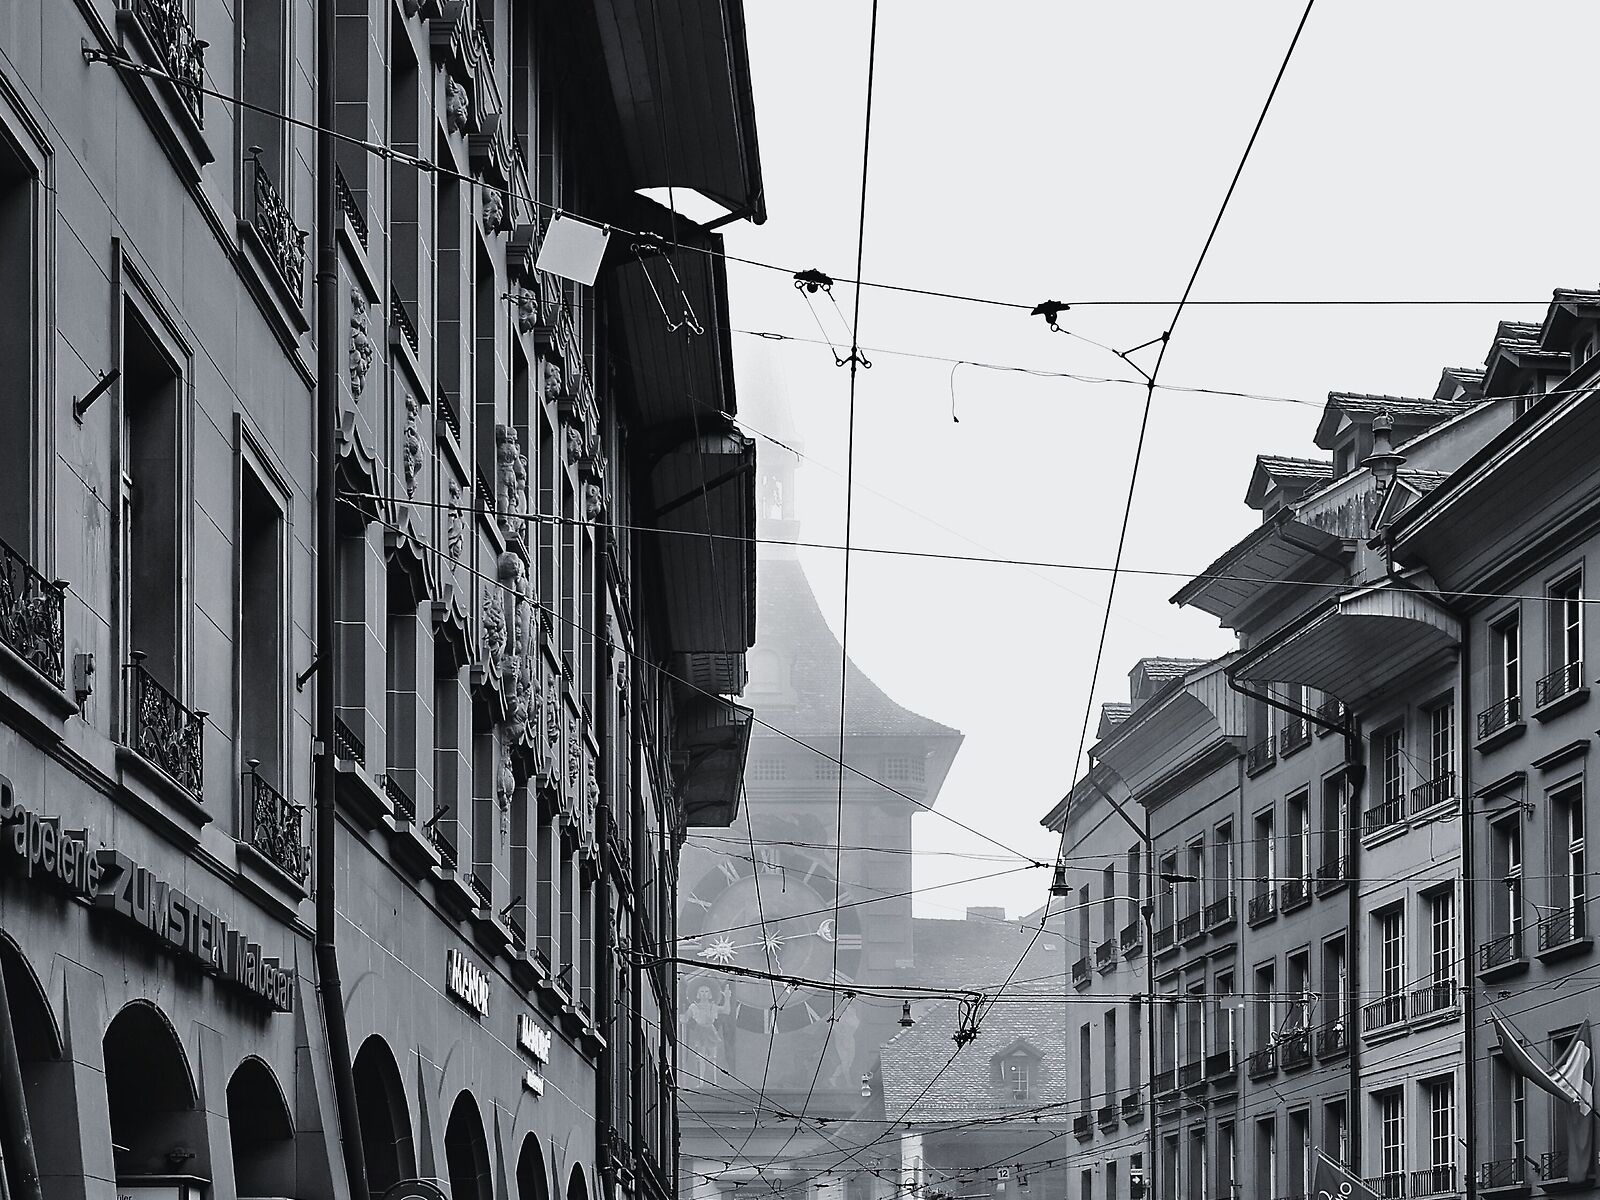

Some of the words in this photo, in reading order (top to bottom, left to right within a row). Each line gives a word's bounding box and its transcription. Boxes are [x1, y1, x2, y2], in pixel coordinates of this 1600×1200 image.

[0, 773, 99, 898] Papeterie
[114, 850, 228, 974] ZUMSTEIN
[998, 1169, 1009, 1178] 12
